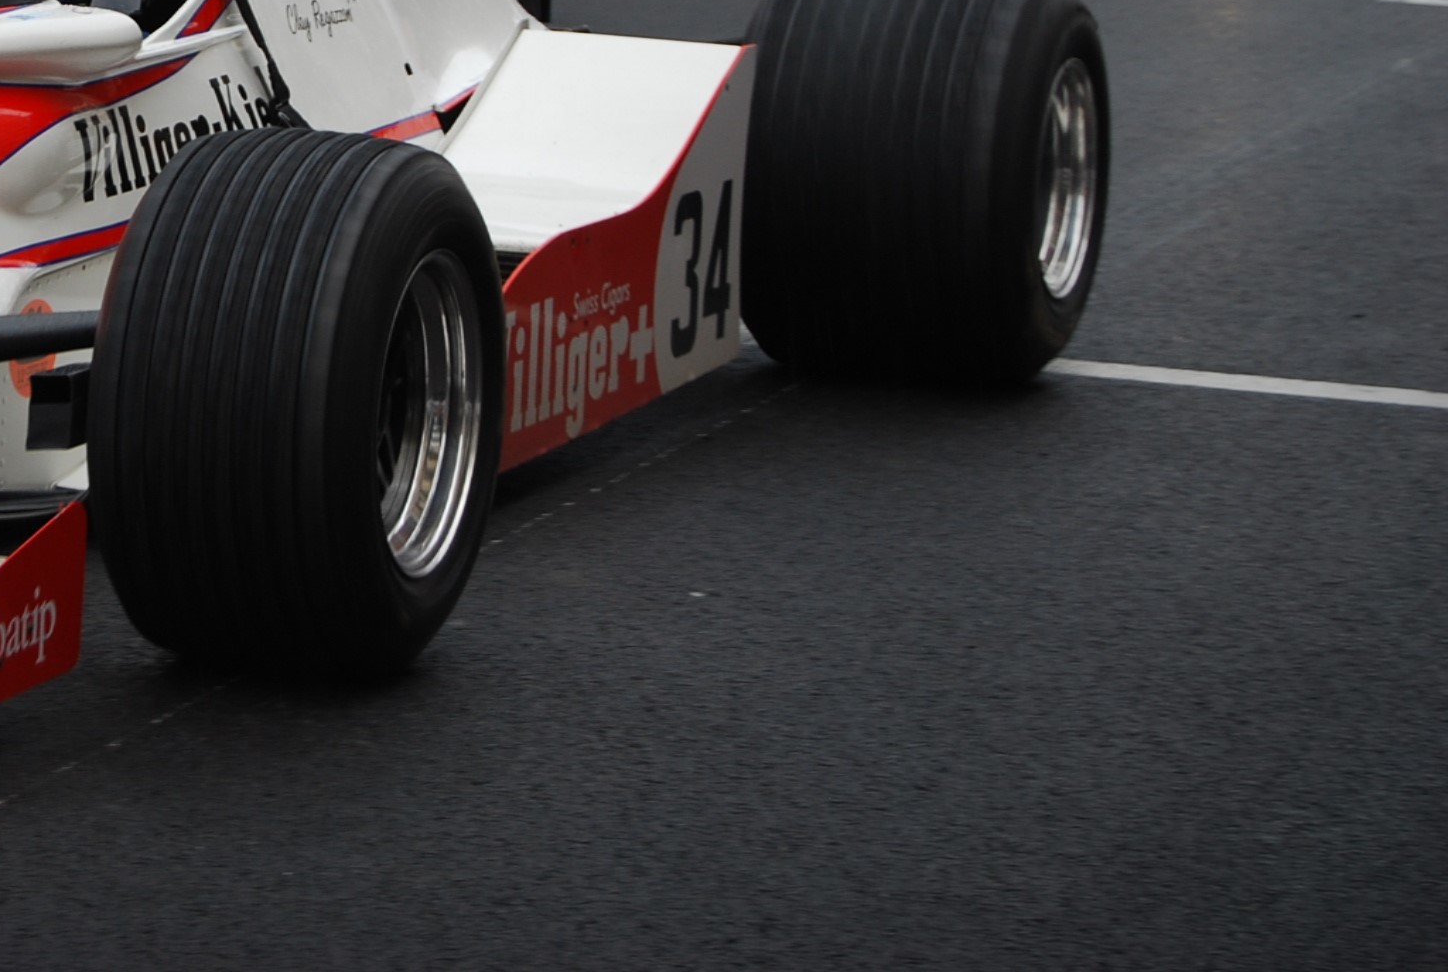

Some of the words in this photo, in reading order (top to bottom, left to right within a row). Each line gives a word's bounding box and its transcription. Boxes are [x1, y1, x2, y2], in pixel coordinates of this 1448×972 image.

[573, 290, 599, 320] Swiss
[601, 281, 631, 315] Cigars
[669, 178, 733, 359] 34
